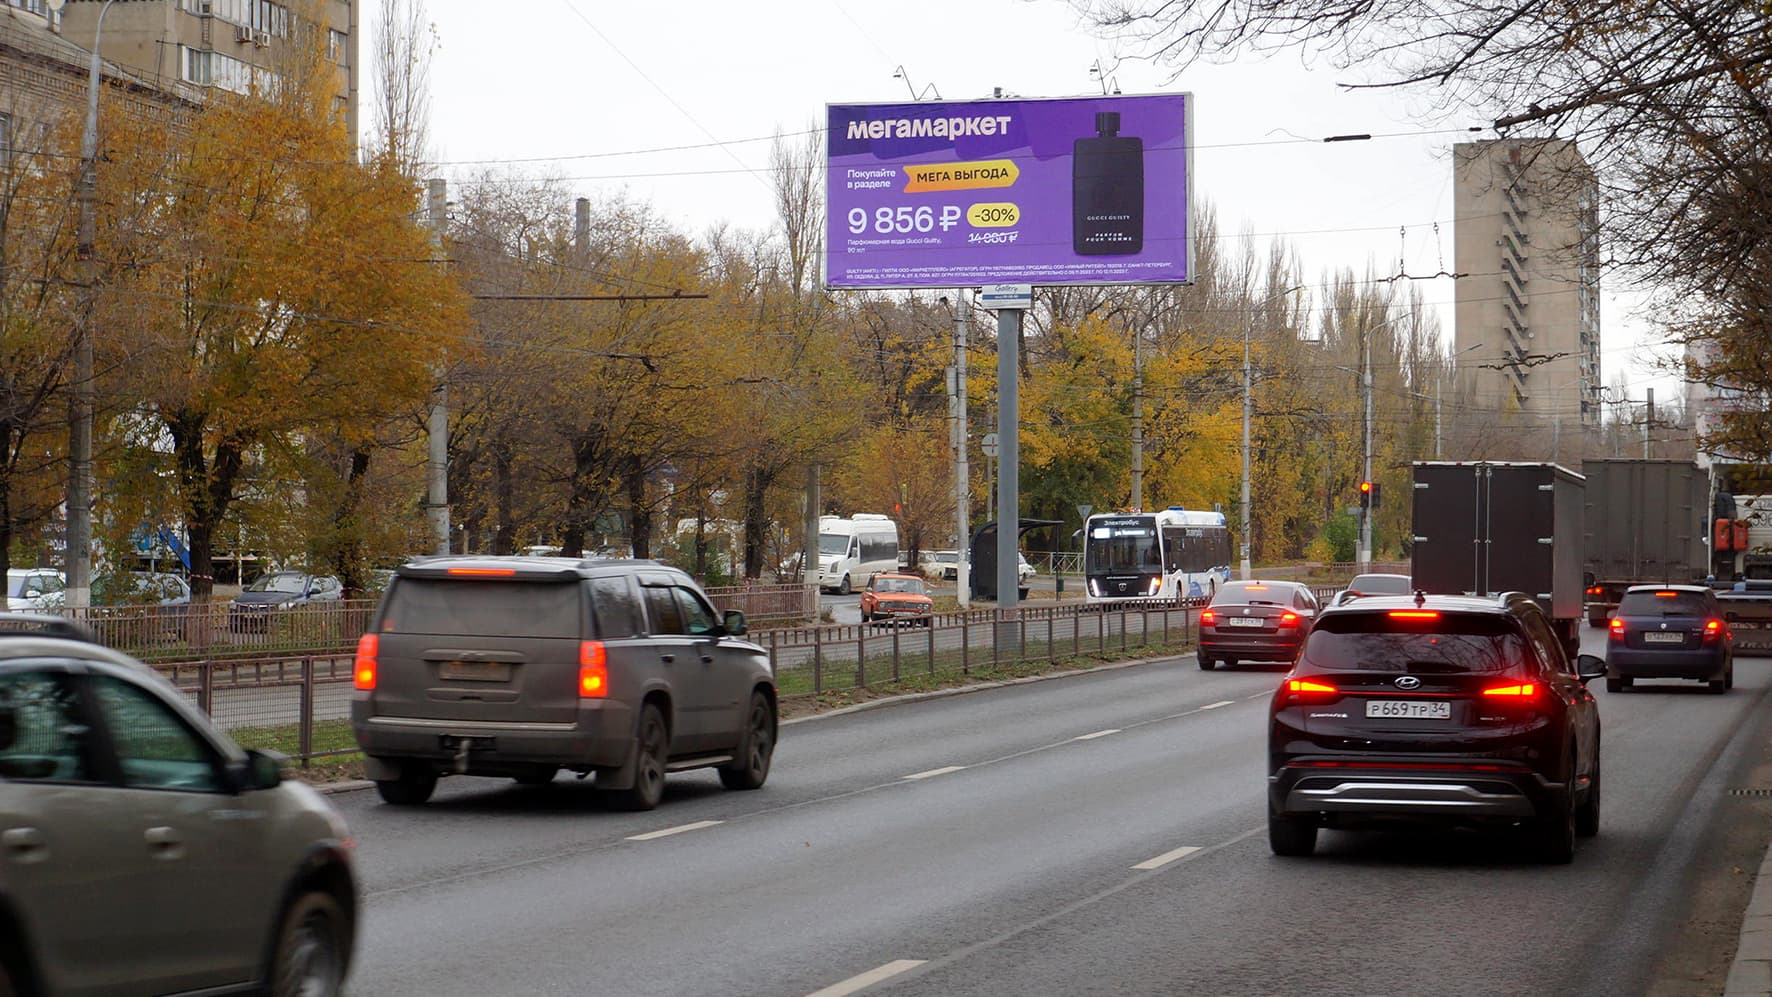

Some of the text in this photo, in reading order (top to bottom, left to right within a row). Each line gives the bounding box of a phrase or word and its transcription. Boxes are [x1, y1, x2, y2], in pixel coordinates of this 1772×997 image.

[847, 116, 1011, 141] мегамаркет
[847, 168, 896, 180] Покупайте
[917, 168, 1009, 183] МЕГА ВЫГОДА
[854, 180, 891, 190] разделе
[847, 207, 868, 234] 9
[874, 206, 934, 234] 856
[974, 208, 1015, 222] -30%
[1431, 702, 1445, 714] 34
